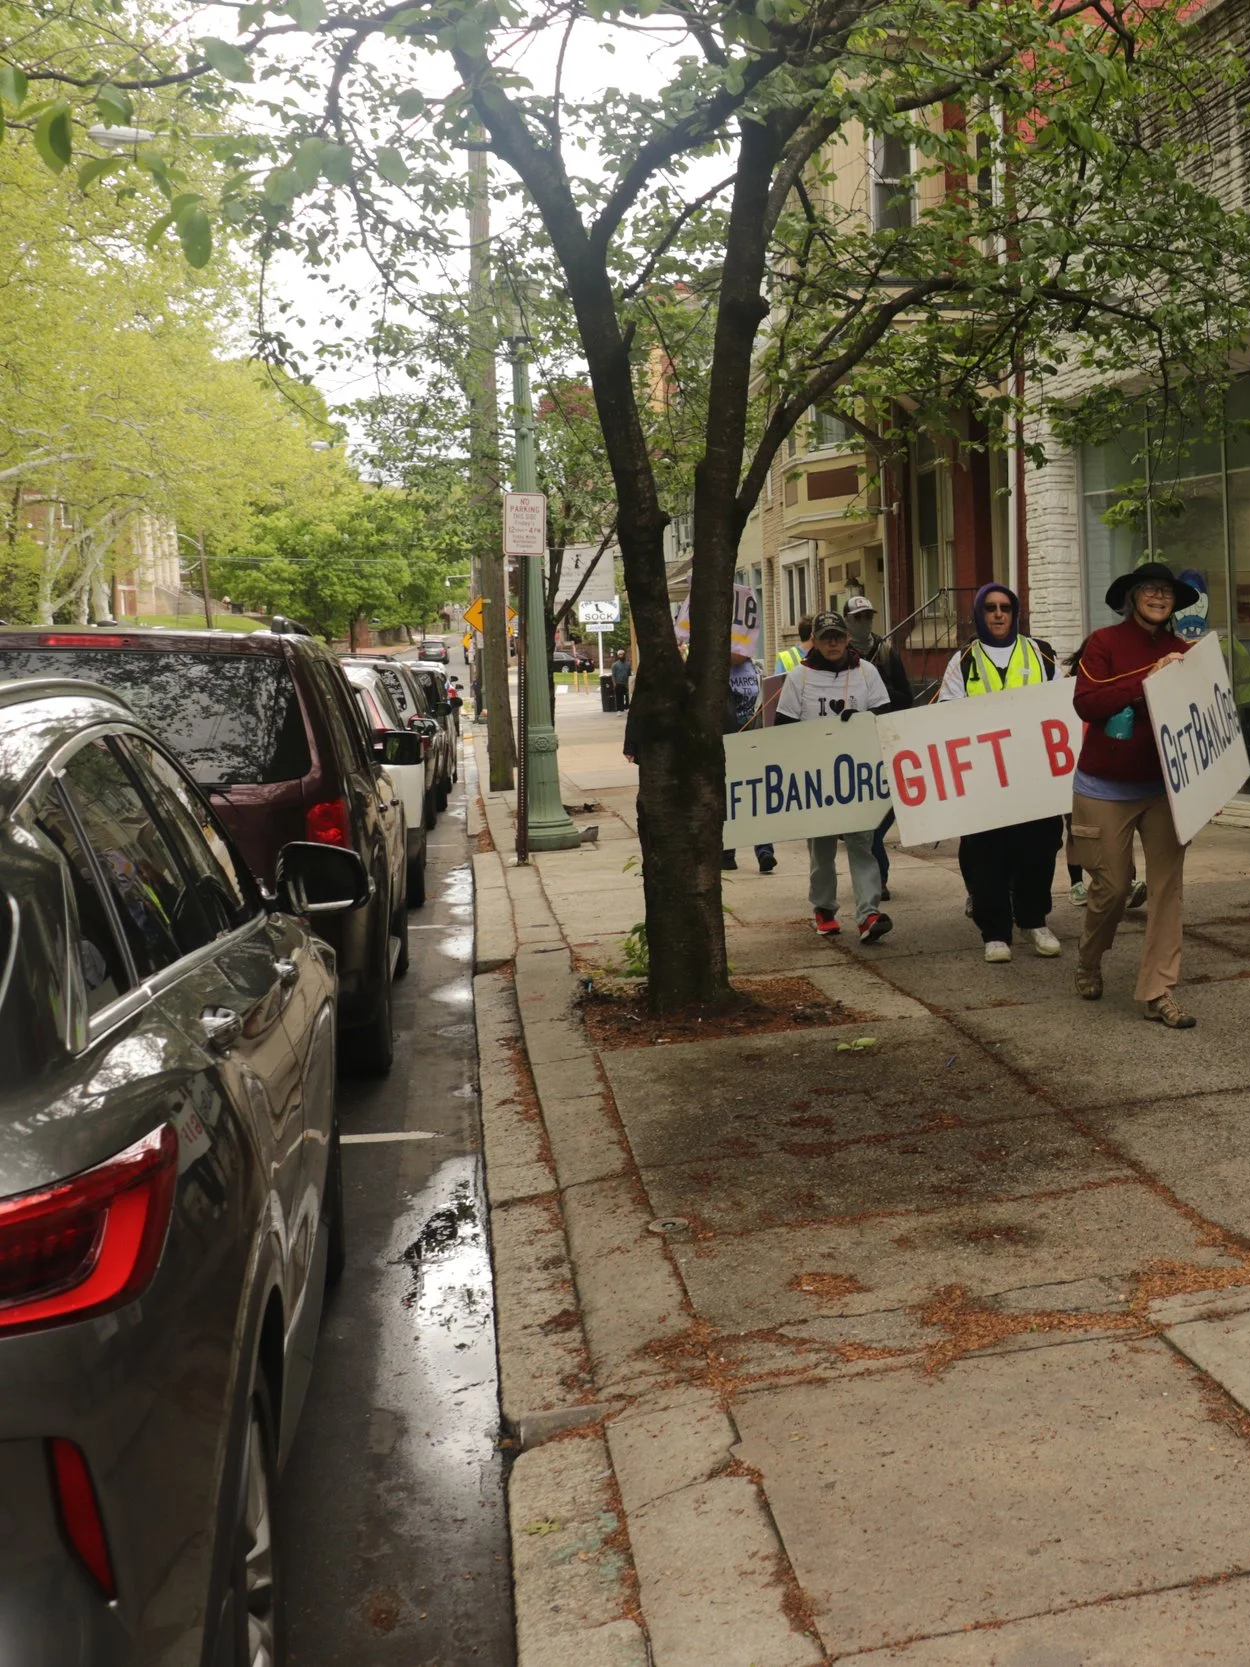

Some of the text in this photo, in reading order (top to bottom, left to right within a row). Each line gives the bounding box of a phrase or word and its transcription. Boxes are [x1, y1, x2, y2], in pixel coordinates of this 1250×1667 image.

[520, 498, 530, 506] NO
[510, 505, 540, 513] PARKING
[584, 613, 614, 621] SOCK
[730, 676, 758, 688] MARCH
[893, 719, 1076, 806] GIFT B
